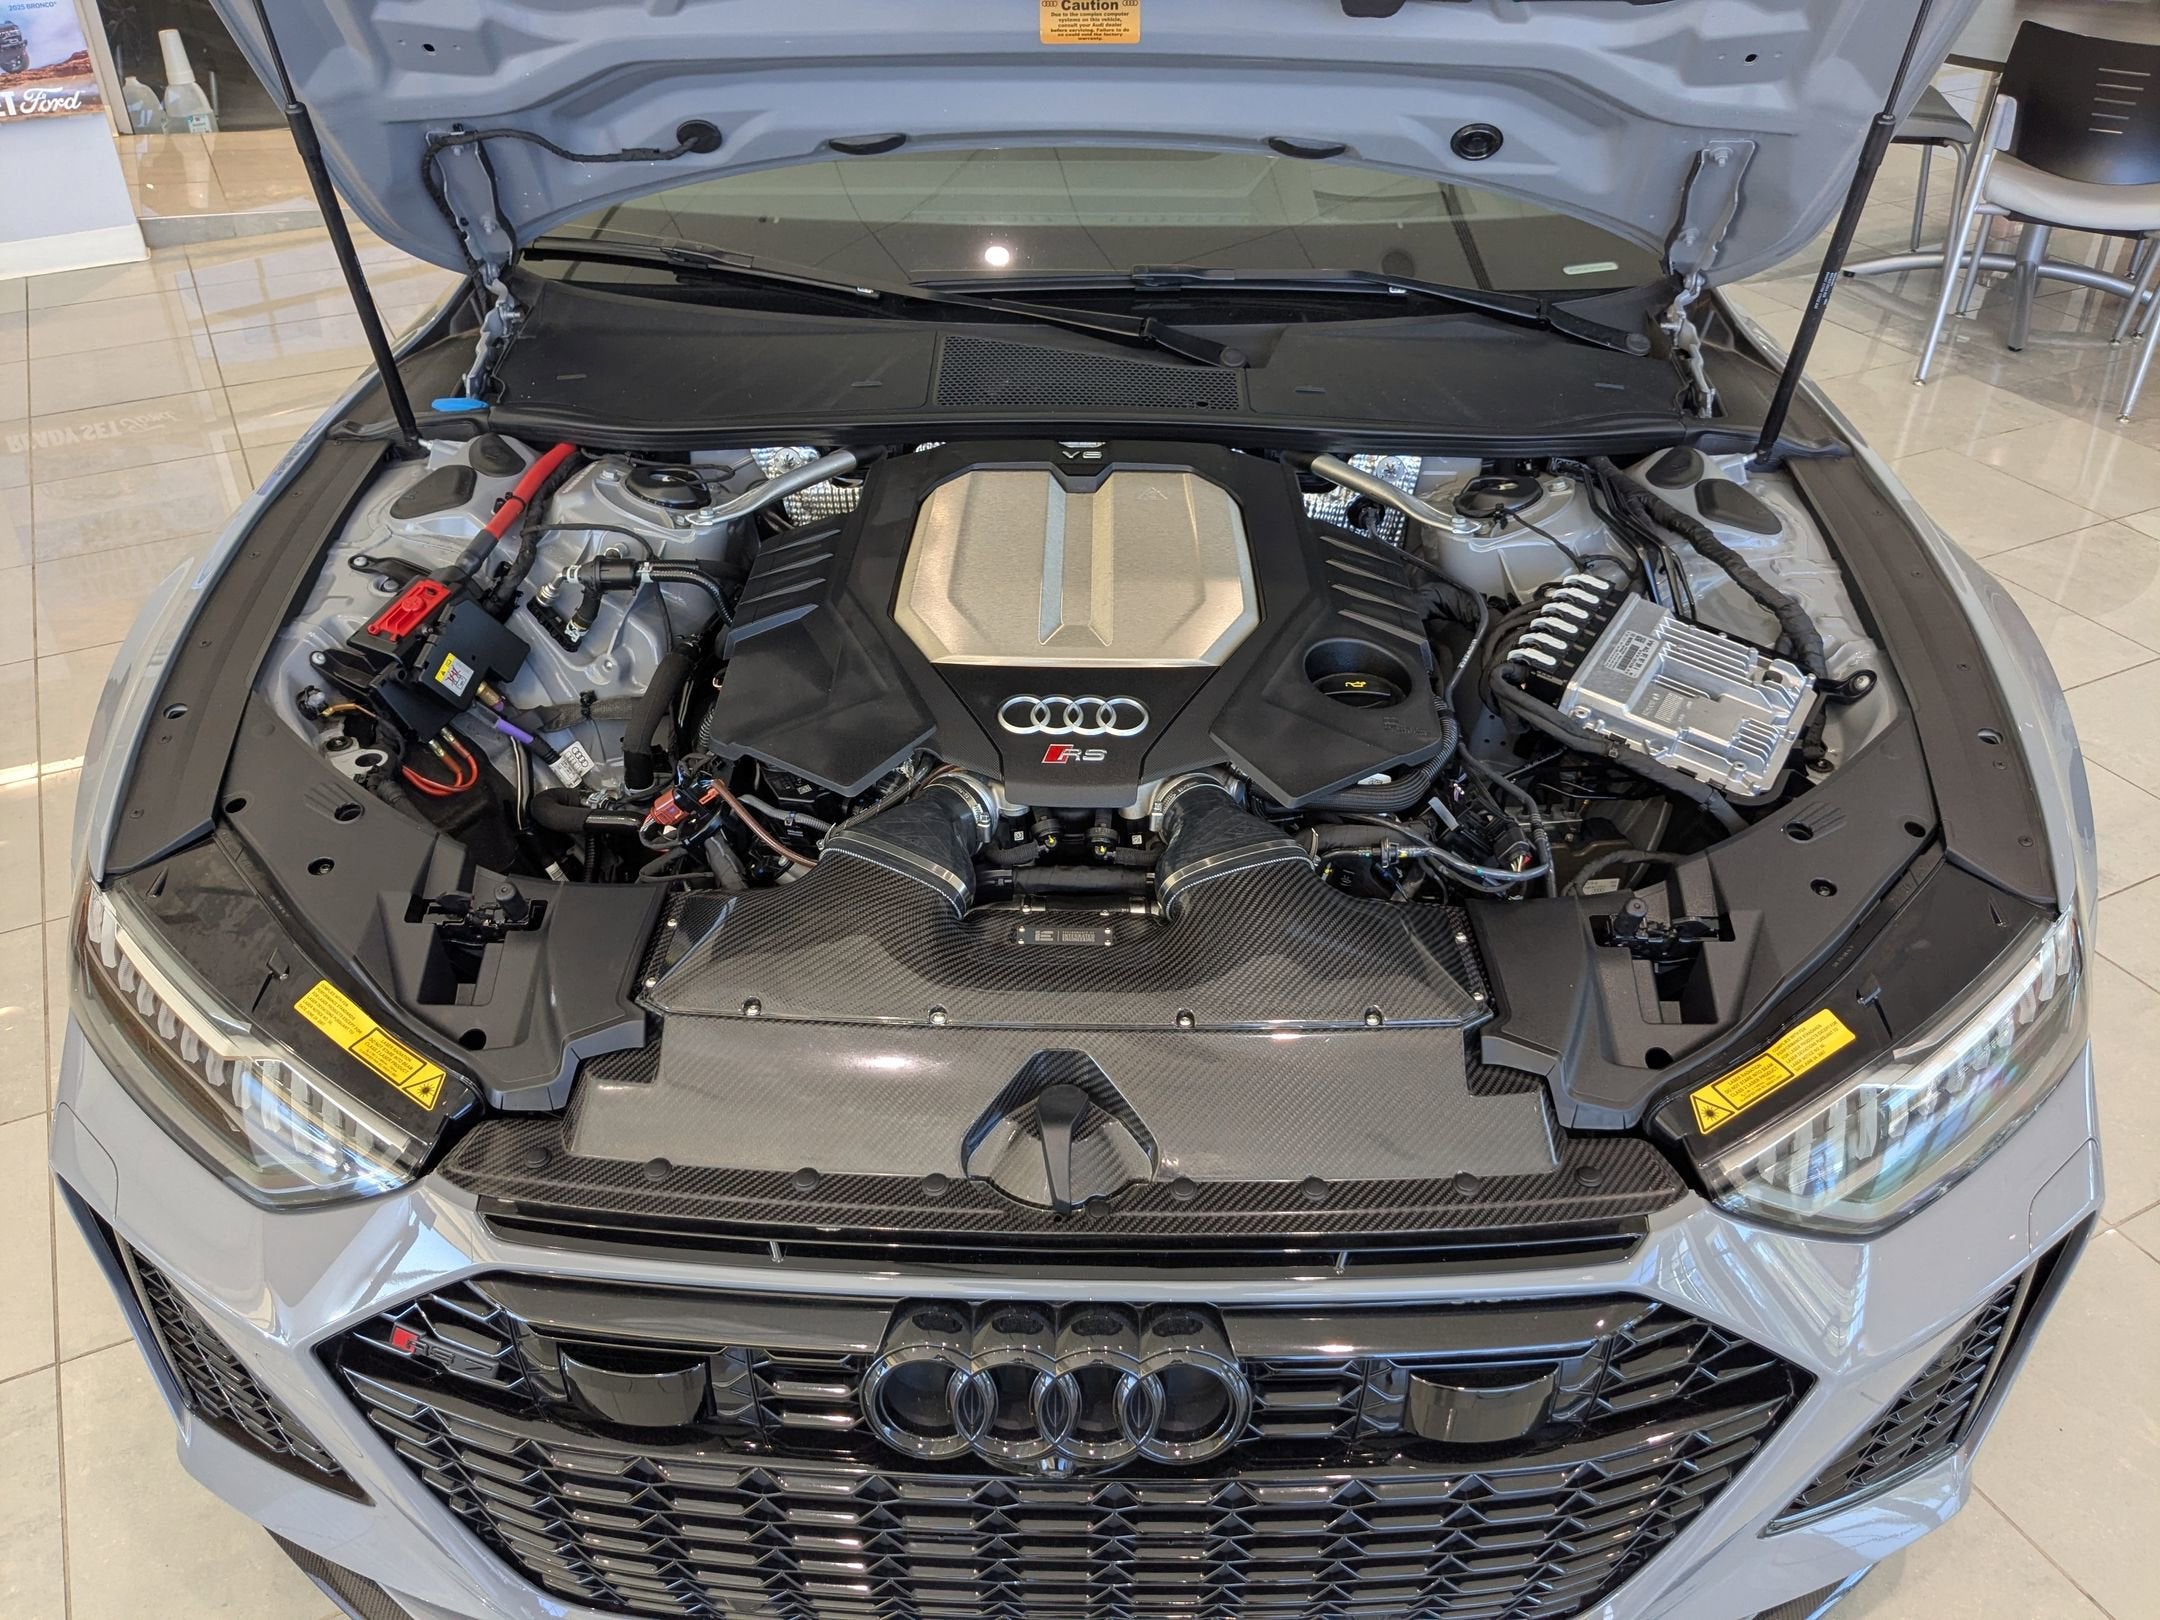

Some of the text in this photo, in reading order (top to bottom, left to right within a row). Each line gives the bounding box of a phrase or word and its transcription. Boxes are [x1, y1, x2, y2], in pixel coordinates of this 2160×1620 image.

[1061, 0, 1119, 10] Caution
[20, 86, 82, 114] Ford
[1049, 746, 1107, 763] RS
[400, 1334, 455, 1364] RS
